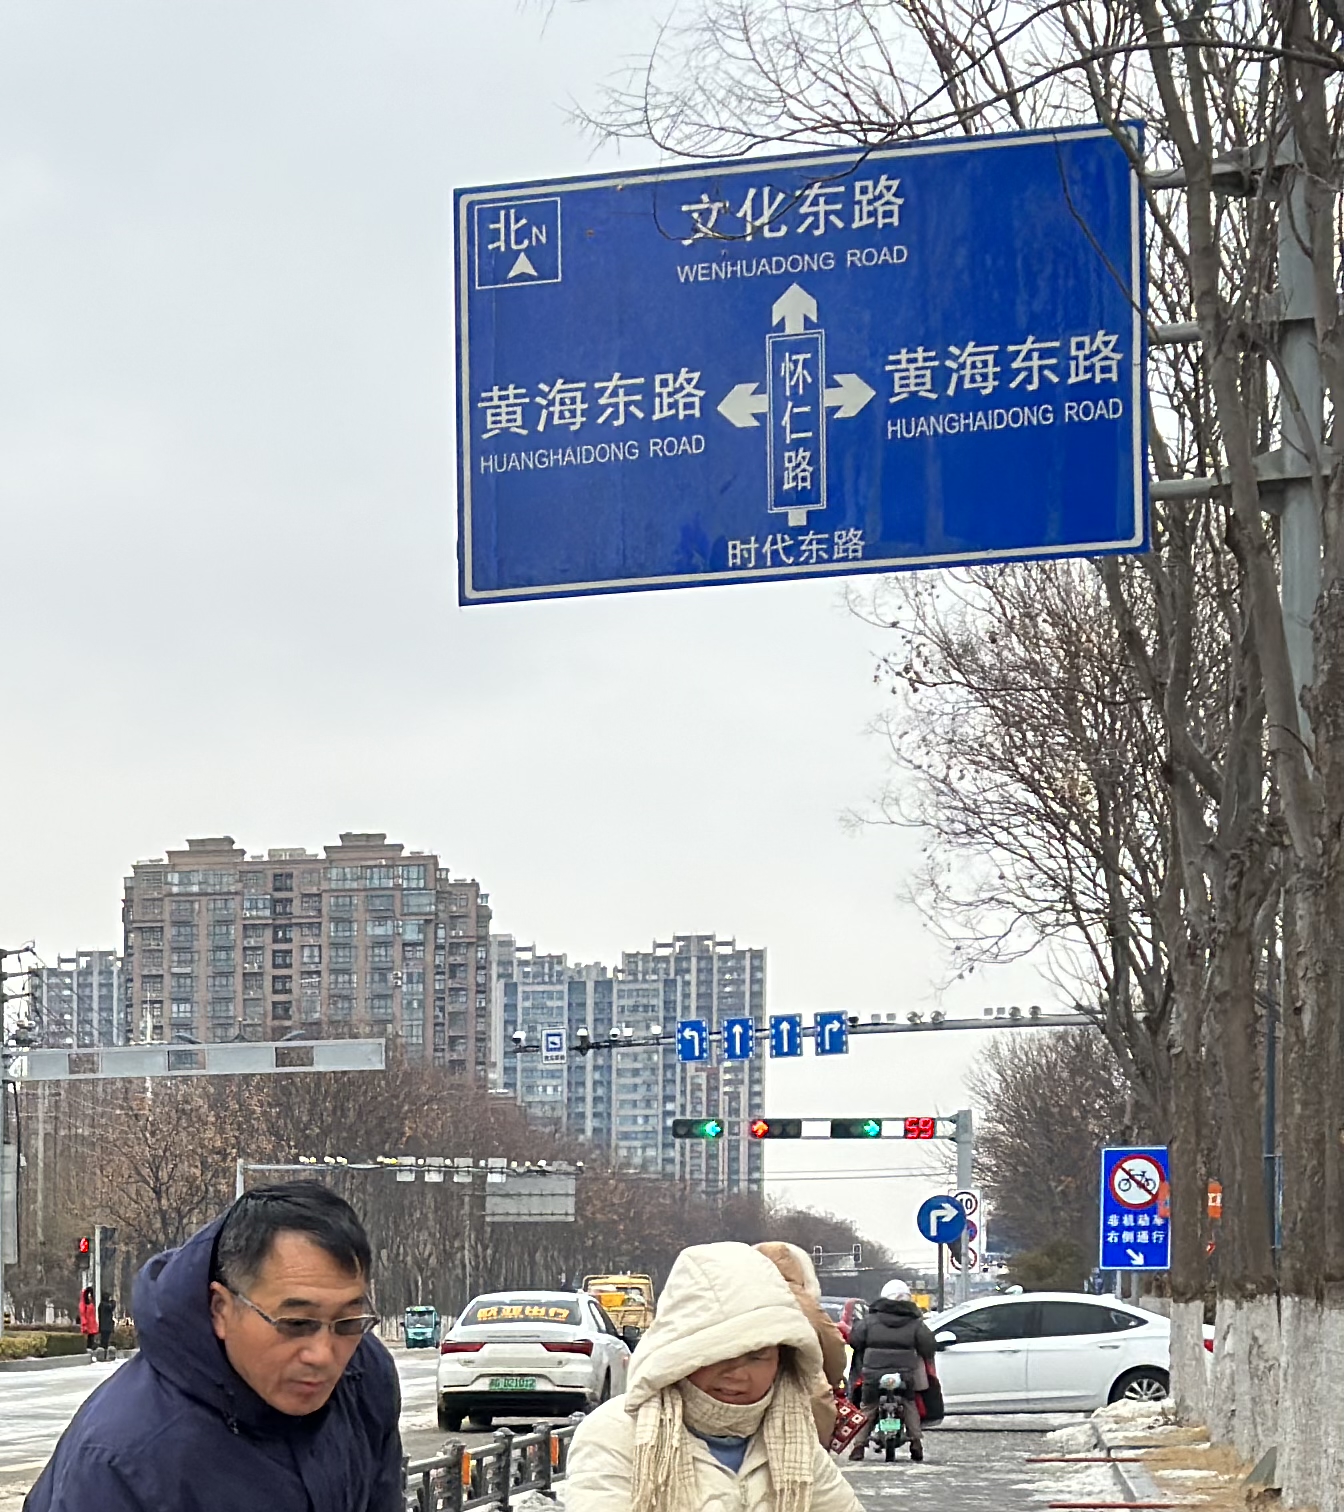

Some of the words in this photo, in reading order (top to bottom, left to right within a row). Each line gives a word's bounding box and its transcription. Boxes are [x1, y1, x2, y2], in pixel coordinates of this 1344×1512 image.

[487, 208, 529, 252] 北
[680, 173, 905, 246] 文化东路
[531, 223, 547, 247] N
[676, 251, 836, 284] WENHUADONG
[845, 244, 909, 269] ROAD
[884, 328, 1125, 404] 黄海东路
[477, 366, 707, 440] 黄海东路
[780, 351, 814, 492] 怀仁路
[886, 403, 1055, 440] HUANGHAIDONG
[1063, 397, 1124, 424] ROAD
[480, 440, 640, 475] HUANGHAIDONG
[648, 433, 706, 458] ROAD
[727, 526, 866, 568] 时代东路
[904, 1117, 934, 1139] 59
[1106, 1230, 1165, 1244] 右侧通行
